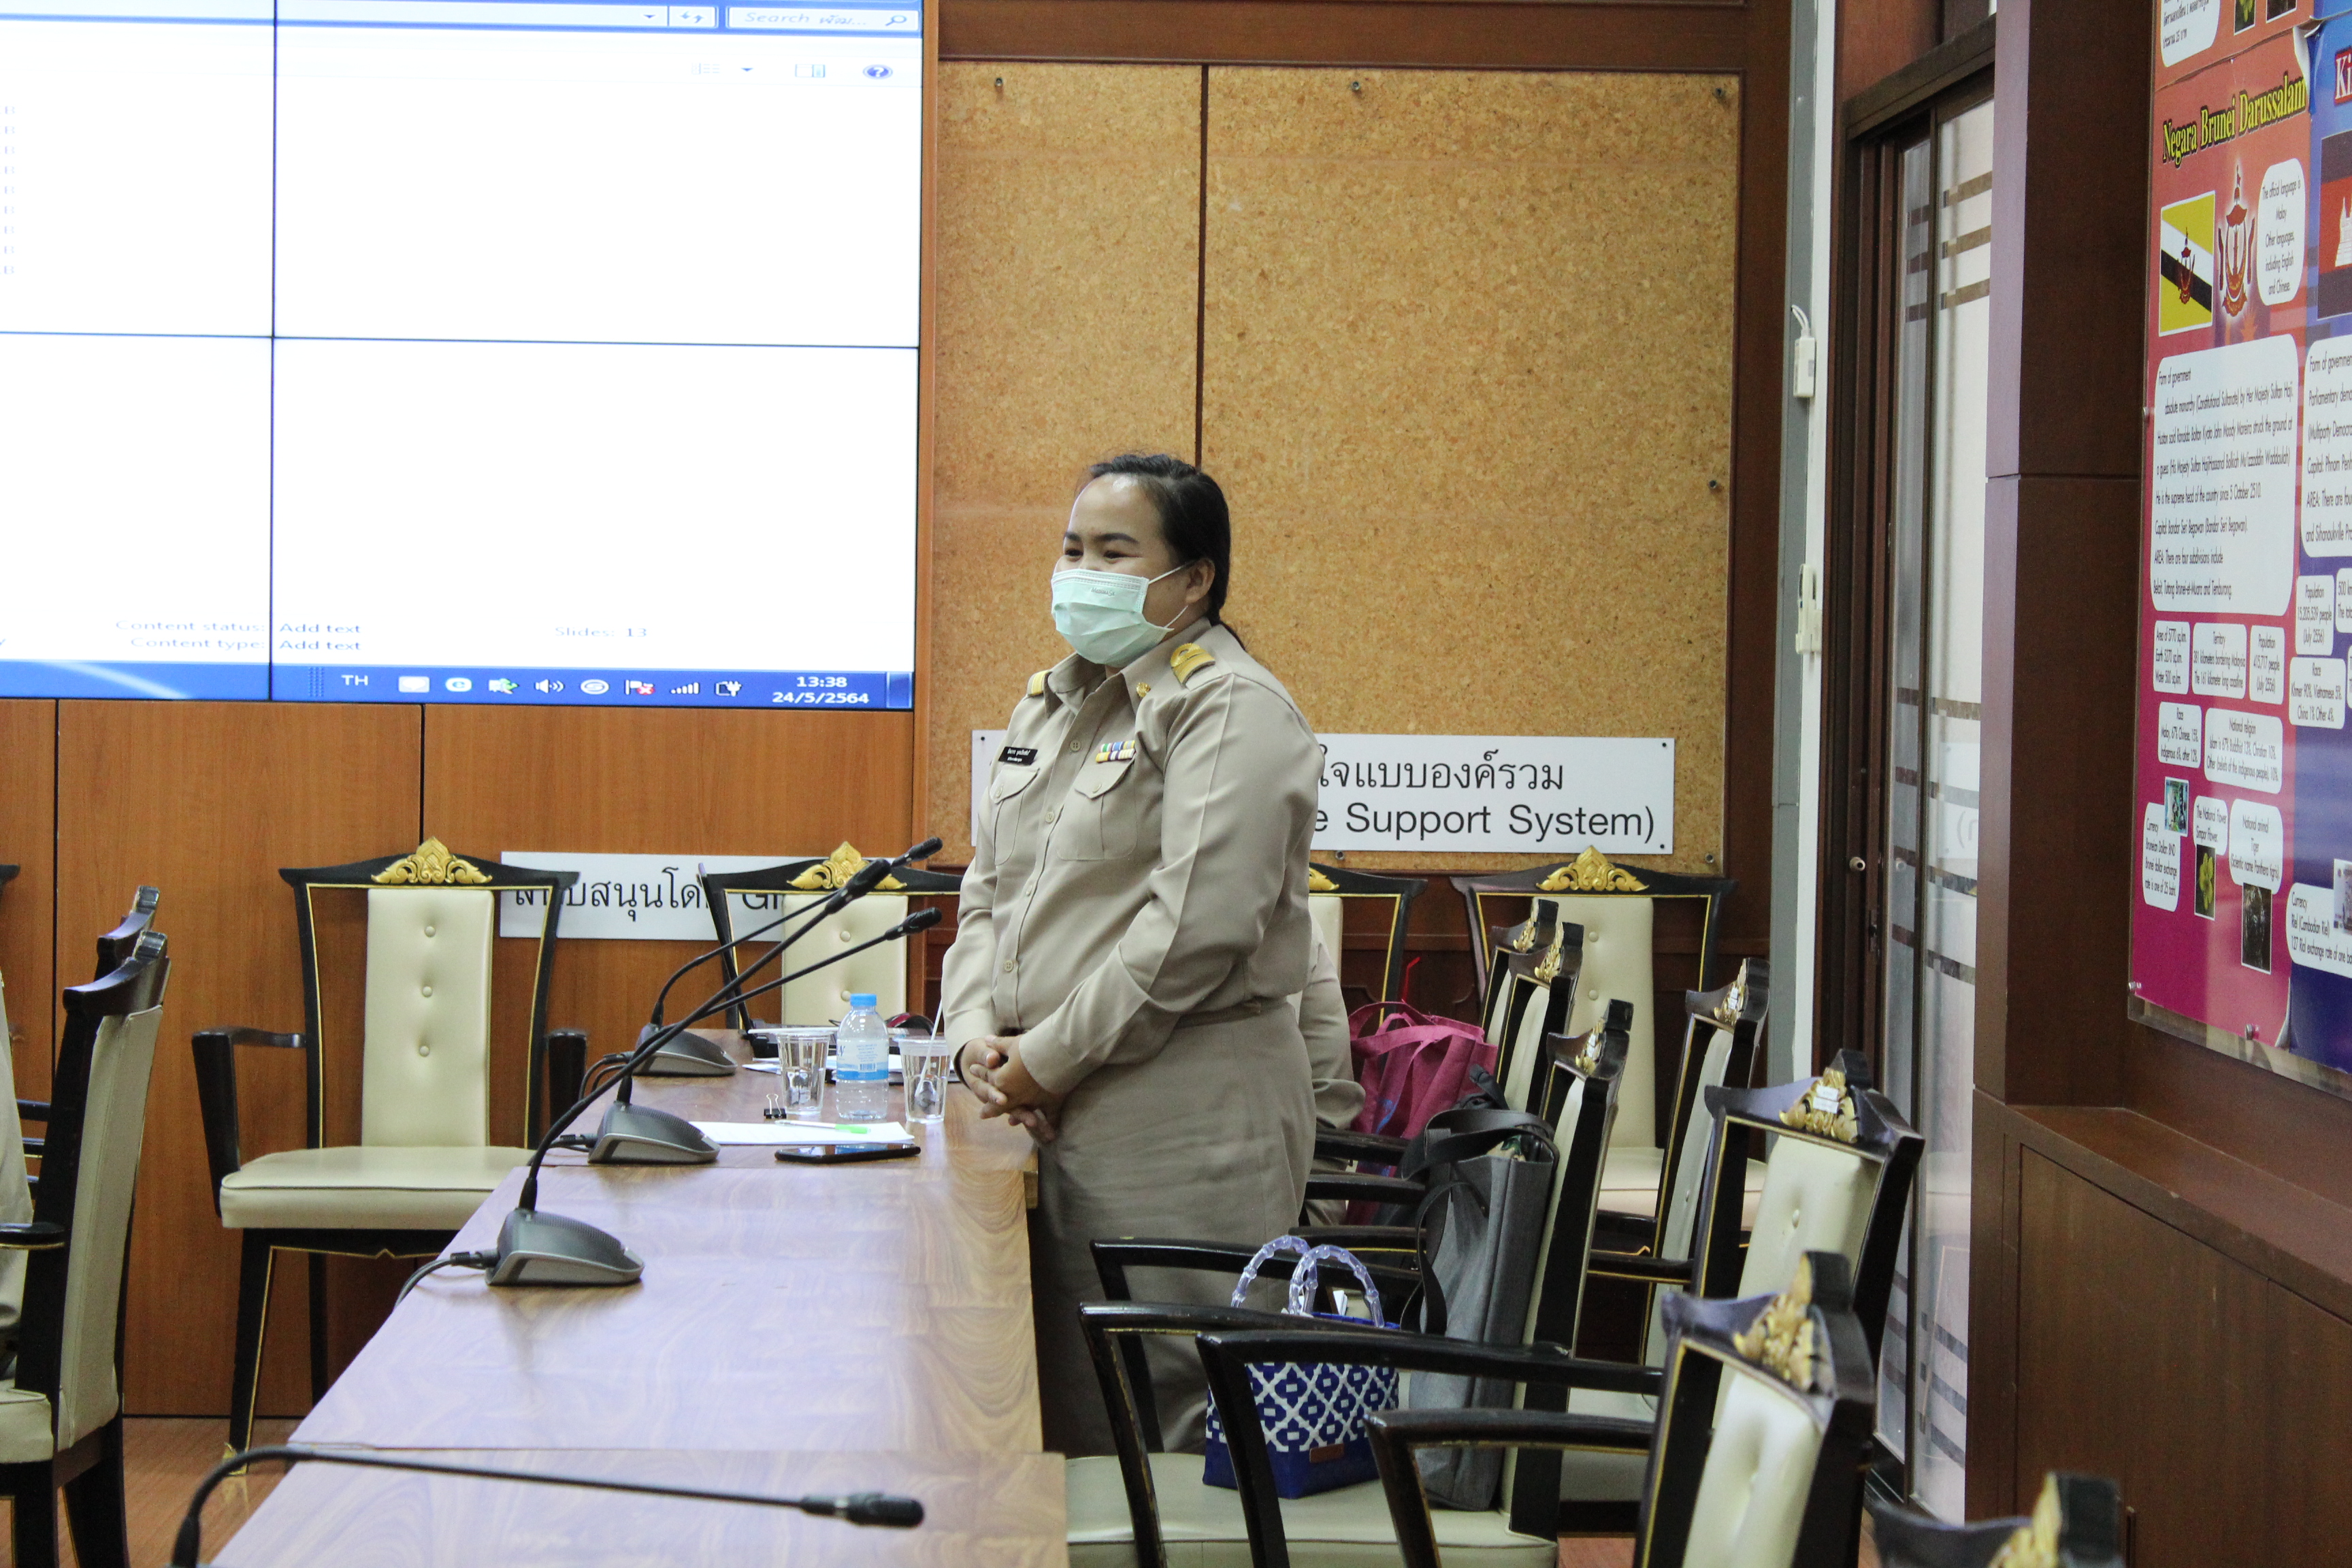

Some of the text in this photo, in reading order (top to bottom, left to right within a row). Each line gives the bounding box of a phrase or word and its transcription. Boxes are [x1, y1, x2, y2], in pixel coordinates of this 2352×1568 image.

[745, 12, 810, 22] Search
[2163, 73, 2306, 167] Negara Brunei Darussalam
[2269, 181, 2280, 198] official
[2280, 180, 2297, 197] language
[2298, 176, 2301, 189] is
[2276, 204, 2287, 222] Malay
[2266, 231, 2276, 248] Other
[2266, 250, 2294, 273] including English
[2310, 350, 2328, 372] Form of
[2270, 380, 2283, 399] Sultan
[2309, 386, 2338, 408] Parliamentary
[2272, 412, 2287, 437] ground
[2325, 453, 2340, 472] Phnom
[2234, 482, 2249, 500] October
[2321, 488, 2334, 506] There
[2335, 494, 2343, 506] are
[2306, 521, 2344, 542] and Sihanoukville
[2305, 582, 2324, 602] Population
[2319, 604, 2332, 625] people
[116, 621, 362, 634] Content status: Add text
[555, 627, 647, 638] Slides: 13
[131, 638, 362, 651] Content type: Add text
[2312, 662, 2321, 676] Race
[341, 674, 369, 686] TH
[796, 676, 848, 688] 13:38
[772, 691, 870, 705] 24/5/2564
[2291, 681, 2335, 700] Khmer Vietnamese
[2297, 704, 2308, 720] China
[2315, 704, 2327, 721] Other
[1345, 802, 1491, 842] Support
[1508, 804, 1656, 845] System)
[2291, 892, 2308, 913] Currency
[2299, 915, 2321, 934] (Cambodian
[2307, 939, 2325, 961] exchange
[2334, 944, 2338, 961] of
